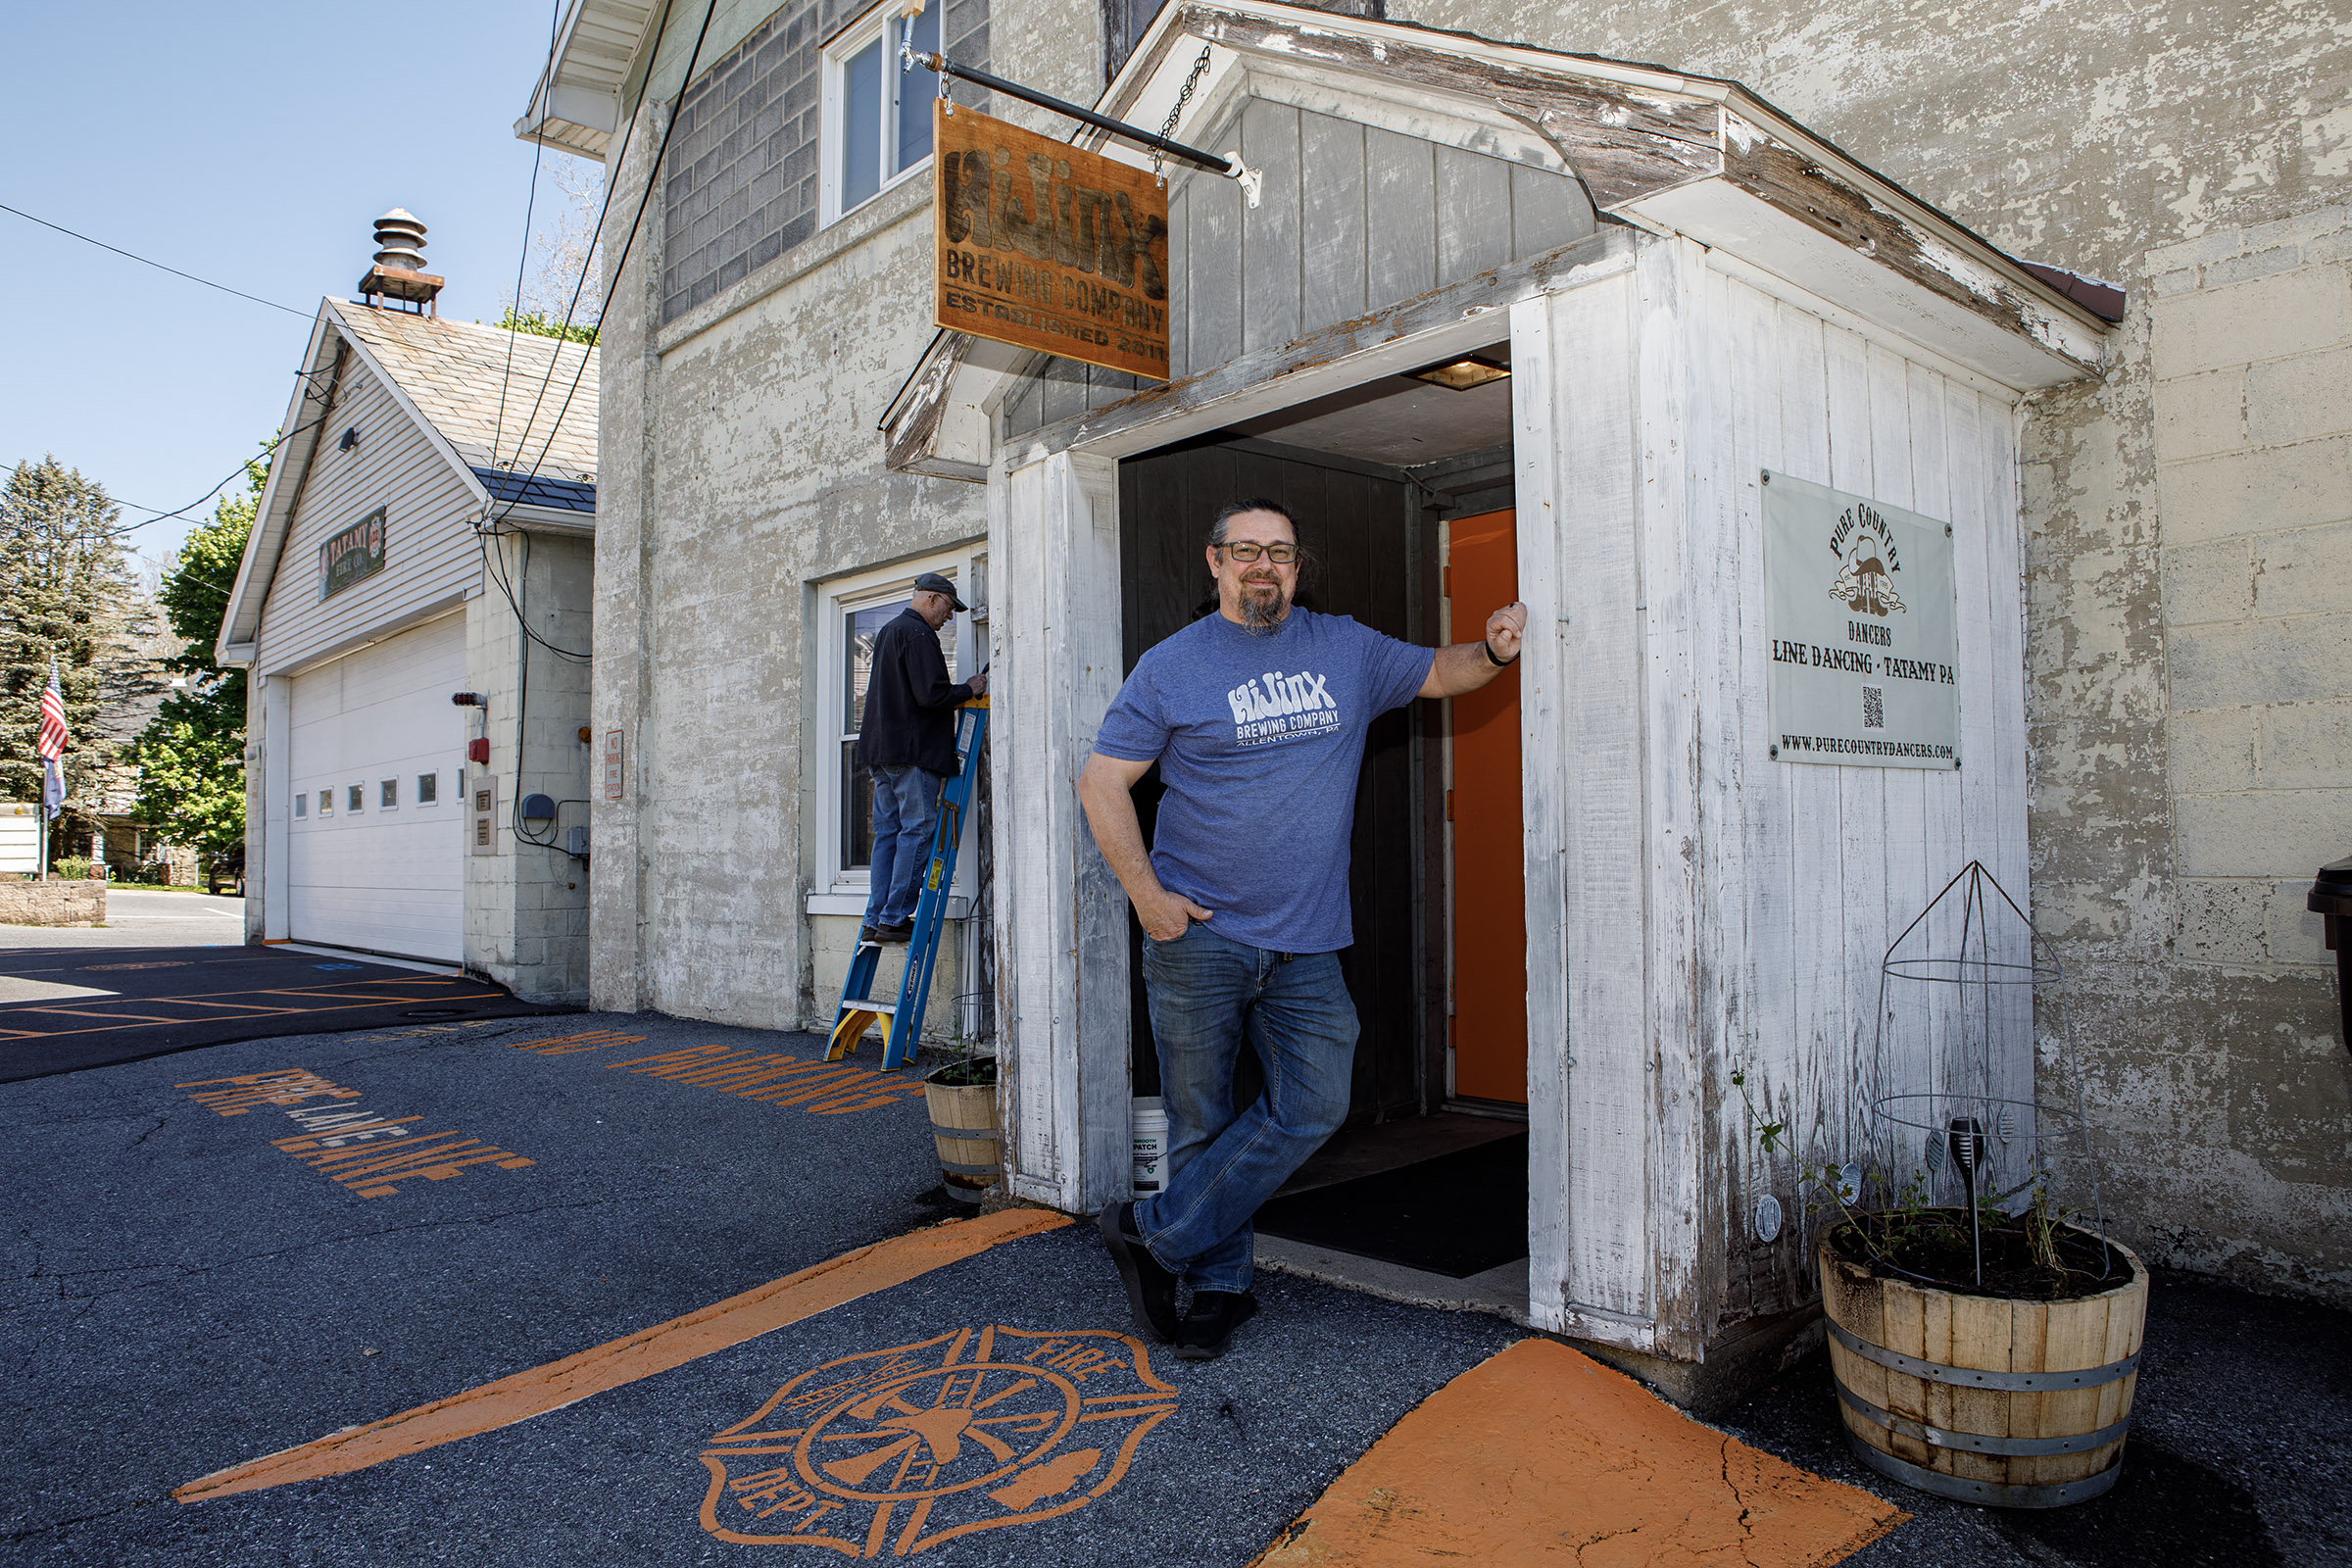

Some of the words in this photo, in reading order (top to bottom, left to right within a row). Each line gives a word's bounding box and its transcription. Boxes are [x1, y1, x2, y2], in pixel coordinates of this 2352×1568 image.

[947, 249, 1053, 305] BREWING
[1062, 275, 1164, 334] COMPANY
[946, 291, 1108, 347] ESTABLISHED
[1116, 335, 1164, 362] 2011
[329, 522, 368, 567] TATAMY
[1830, 508, 1855, 562] PURE
[1858, 503, 1901, 573] COUNTRY
[335, 558, 353, 577] FIRE
[1847, 620, 1892, 647] DANCERS
[1772, 639, 1808, 664] LINE
[1811, 646, 1873, 675] DANCING
[1884, 657, 1936, 682] TATAMY
[1939, 664, 1955, 685] PA
[612, 737, 617, 750] NO
[1236, 730, 1322, 748] ALLENTOWN,
[1326, 725, 1340, 734] PA
[1237, 718, 1287, 739] BREWING
[1290, 710, 1339, 730] COMPANY
[1782, 734, 1954, 760] WWW.PURECOUNTRYDANCERS.COM
[506, 1029, 648, 1055] NO
[604, 1044, 926, 1115] PARKING
[1024, 1338, 1129, 1383] FIRE
